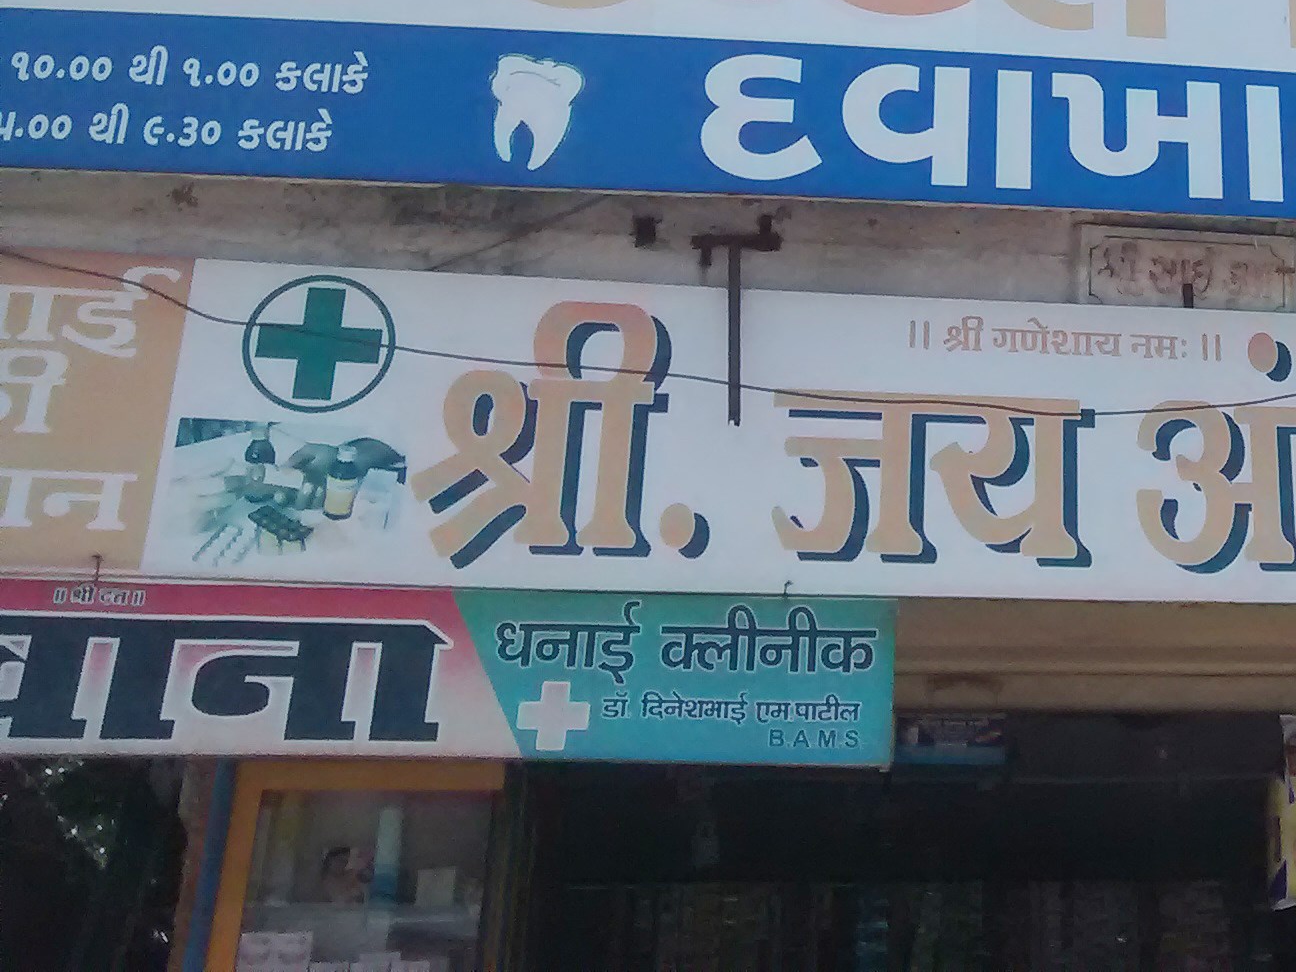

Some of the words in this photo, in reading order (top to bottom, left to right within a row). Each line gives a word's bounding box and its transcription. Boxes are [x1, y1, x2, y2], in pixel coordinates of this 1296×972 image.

[128, 44, 169, 86] થી
[275, 50, 369, 94] કલાકે
[88, 102, 129, 144] થી
[237, 108, 333, 152] કલાકે
[943, 315, 984, 352] श्री
[991, 317, 1122, 356] गणेशाय
[771, 389, 1096, 567] जय
[495, 600, 642, 685] धनाई
[660, 604, 879, 674] क्लीनीक
